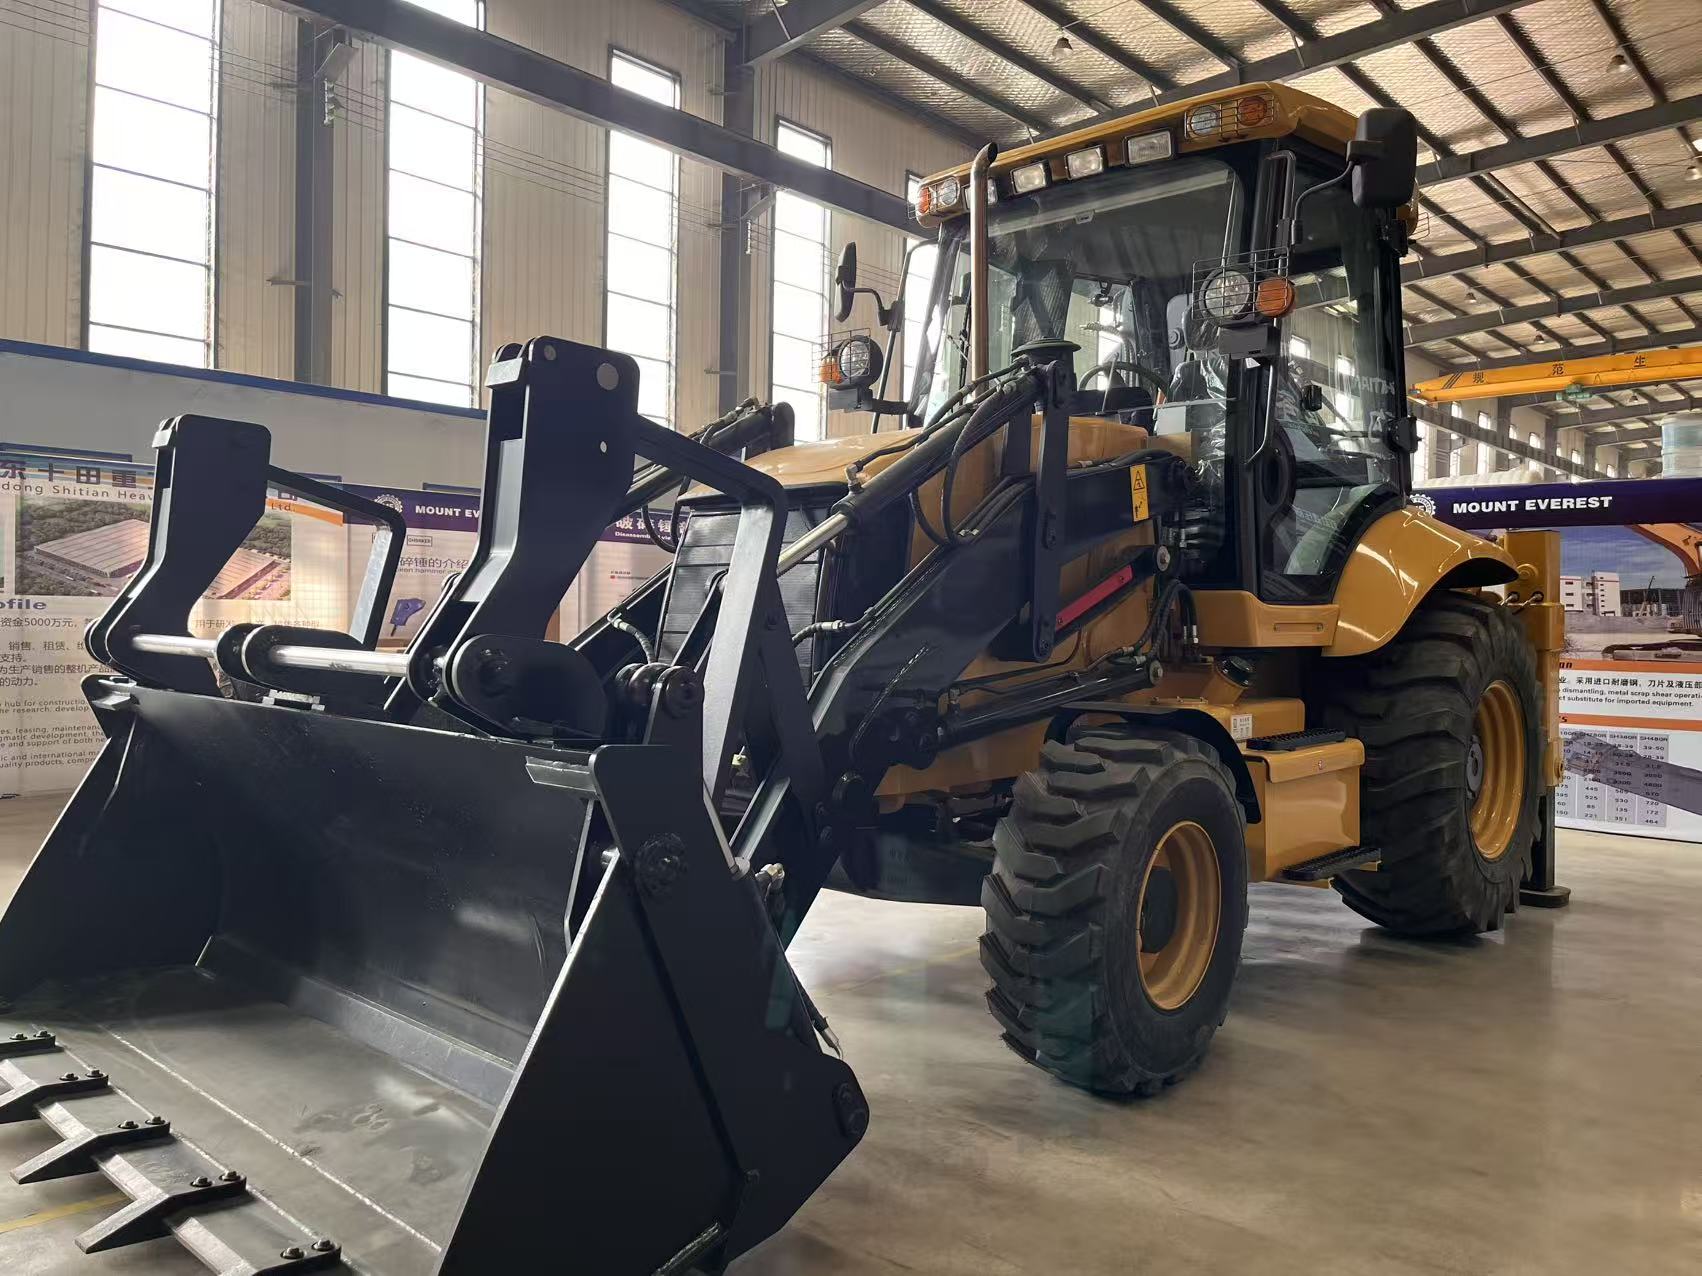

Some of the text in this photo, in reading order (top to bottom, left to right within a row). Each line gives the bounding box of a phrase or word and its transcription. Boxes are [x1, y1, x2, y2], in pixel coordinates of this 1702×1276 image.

[0, 461, 155, 490] 东十田重
[52, 484, 109, 498] Shitian
[1453, 500, 1519, 514] MOUNT
[1524, 496, 1613, 511] EVEREST
[415, 505, 461, 517] MOUNT
[1562, 687, 1606, 696] dismantling,
[1630, 690, 1650, 698] scrap
[1651, 690, 1672, 698] shear
[5, 698, 20, 707] hub
[1616, 697, 1651, 705] imported
[1652, 699, 1695, 707] equipment.
[27, 739, 60, 747] support
[30, 750, 86, 759] international
